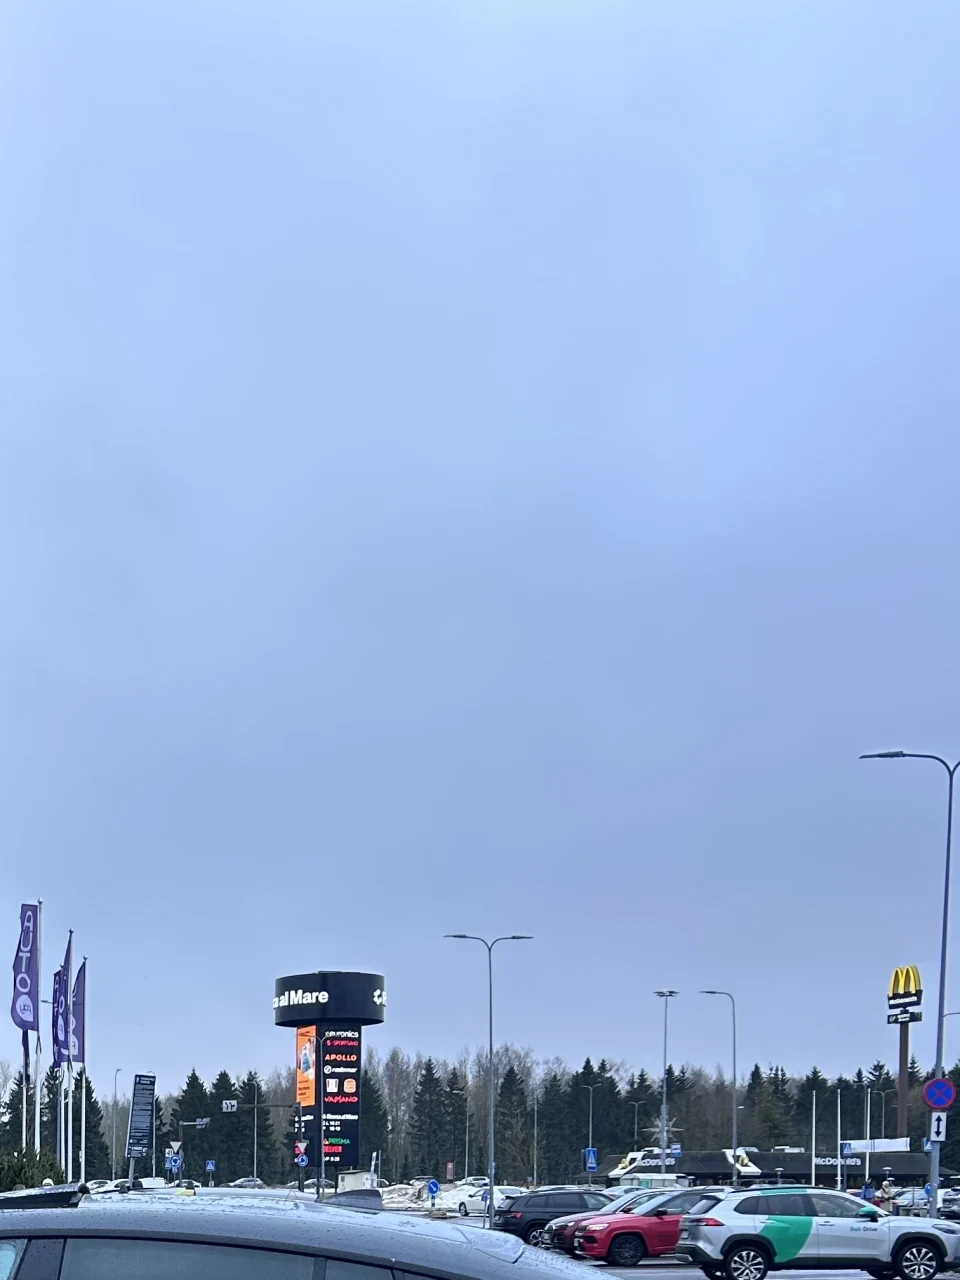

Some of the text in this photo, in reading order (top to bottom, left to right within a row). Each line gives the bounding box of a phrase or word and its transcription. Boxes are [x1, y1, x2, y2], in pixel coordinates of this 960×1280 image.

[16, 910, 34, 993] AUTO
[279, 991, 288, 1007] al
[290, 989, 329, 1006] Mare
[324, 1053, 357, 1062] APOLLO
[324, 1095, 358, 1104] VAPIANO
